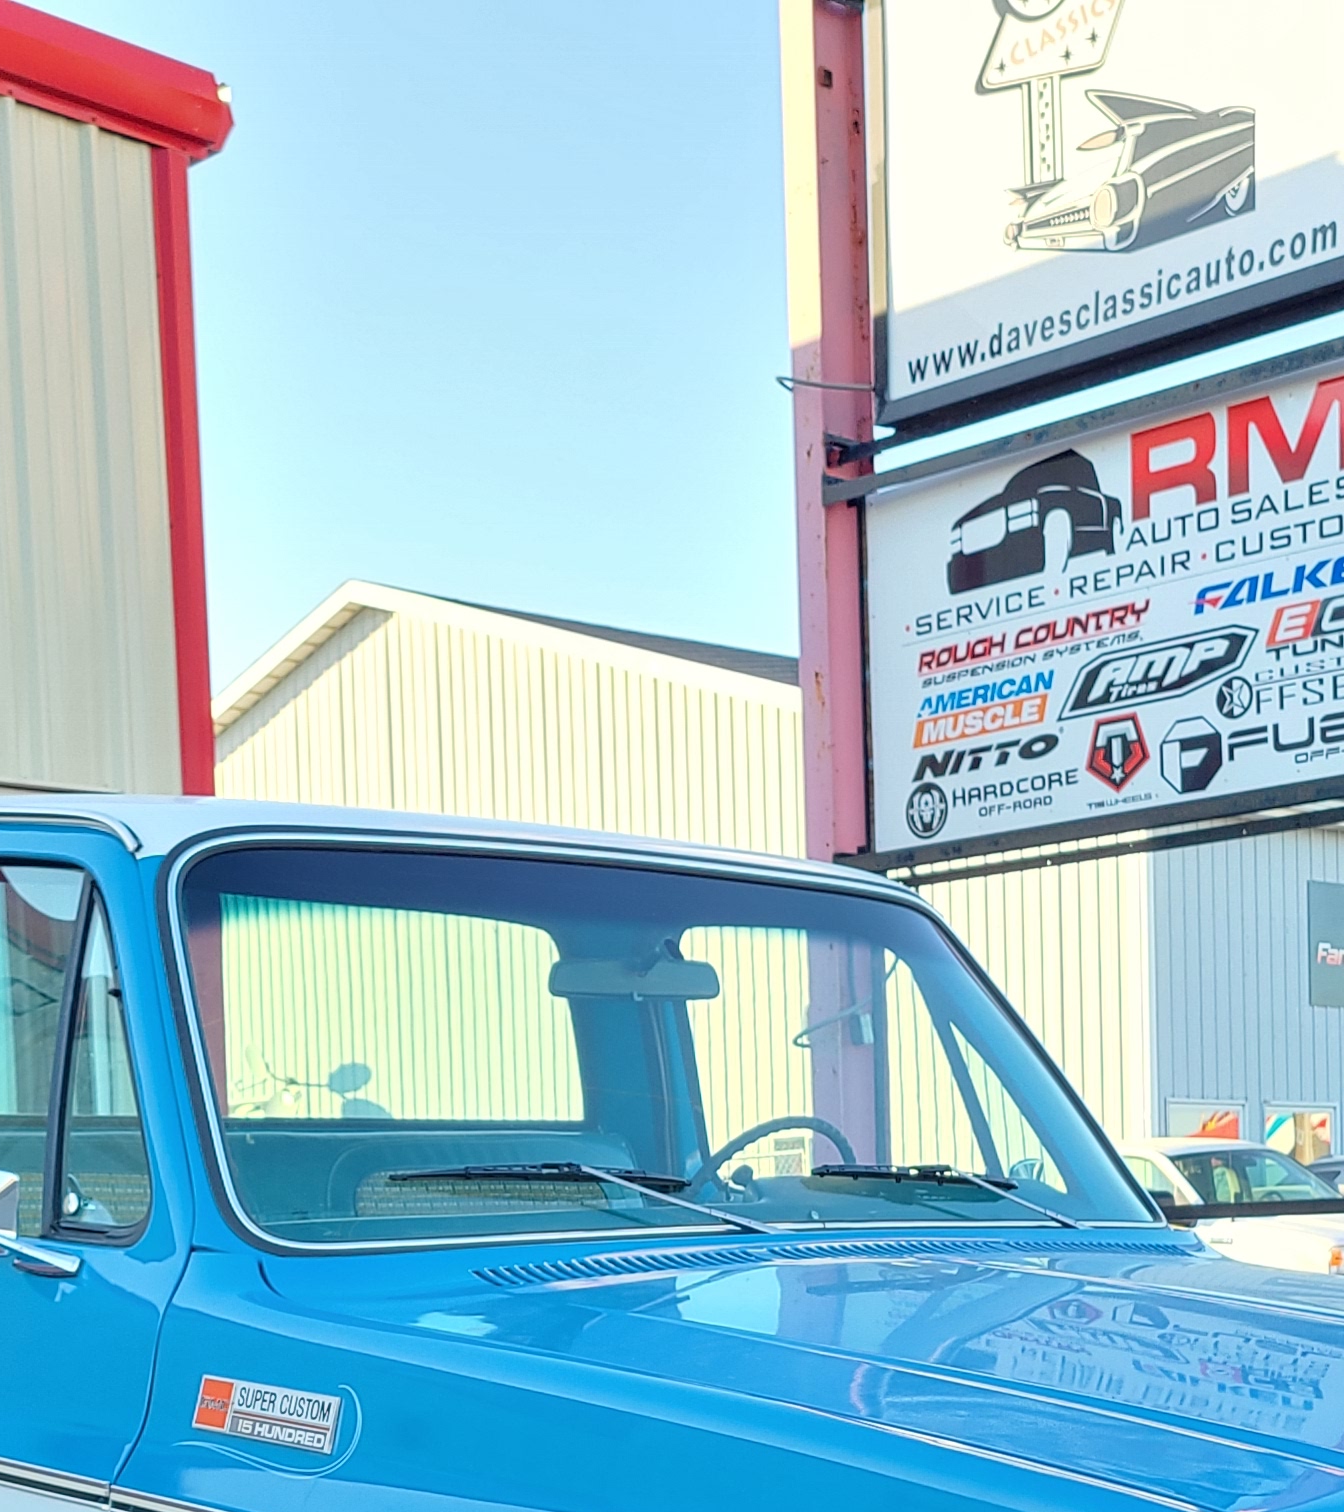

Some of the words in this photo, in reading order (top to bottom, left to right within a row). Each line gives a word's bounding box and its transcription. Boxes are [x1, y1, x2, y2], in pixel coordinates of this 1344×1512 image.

[907, 219, 1339, 384] www.davesclassicauto.com
[1126, 506, 1220, 551] AUTO
[915, 586, 1046, 637] SERVICE
[1069, 551, 1192, 599] REPAIR
[918, 632, 1007, 674] ROUGH
[1014, 598, 1150, 650] COUNTRY
[917, 669, 1055, 719] AMERICAN
[921, 653, 1037, 689] SUSPENSION
[1087, 638, 1230, 704] AMP
[1109, 681, 1159, 704] Tires
[921, 696, 1043, 746] MUSCLE
[912, 732, 1060, 783] NITTO
[951, 767, 1080, 808] HARDCORE
[978, 795, 1053, 818] OFF-ROAD
[237, 1386, 276, 1414] SUPER
[279, 1393, 333, 1424] CUSTOM
[237, 1418, 252, 1434] 15
[254, 1421, 325, 1448] HUNDRED
